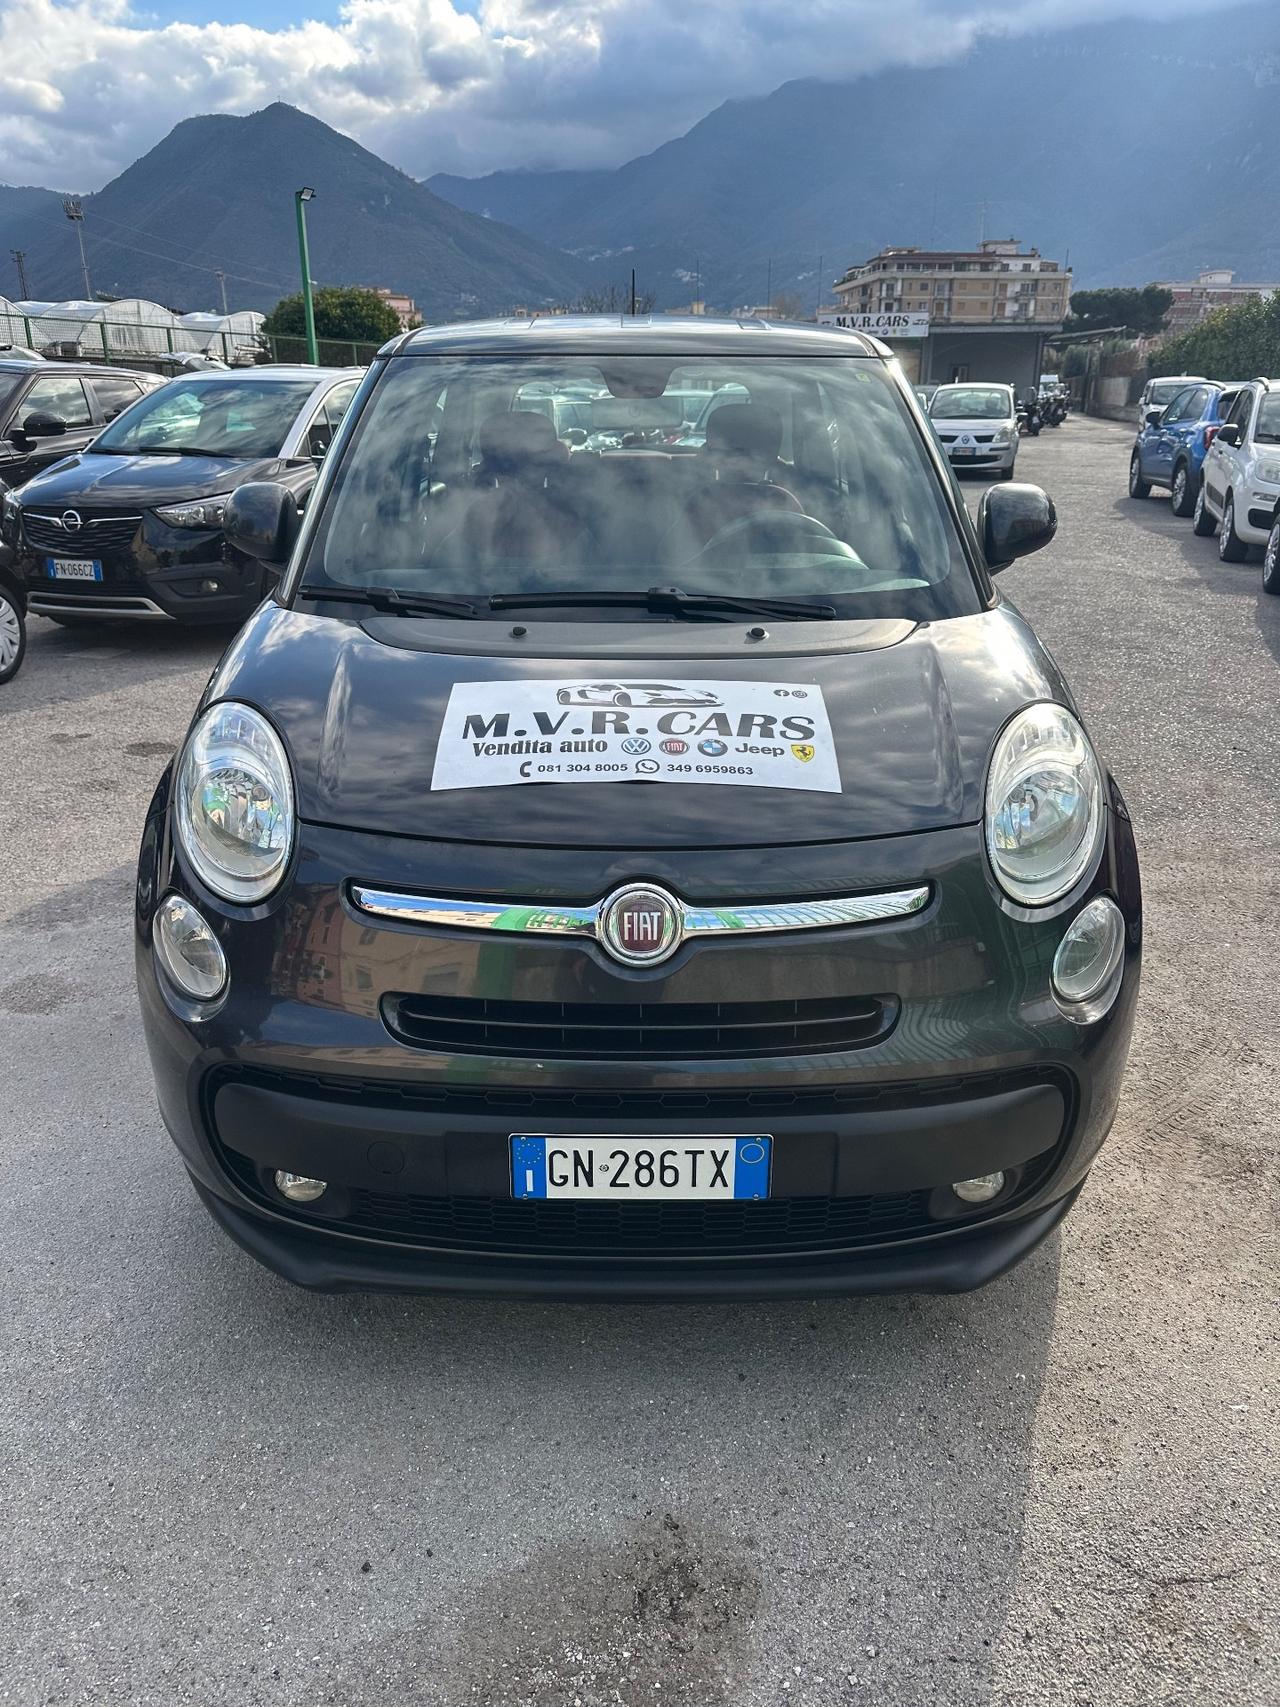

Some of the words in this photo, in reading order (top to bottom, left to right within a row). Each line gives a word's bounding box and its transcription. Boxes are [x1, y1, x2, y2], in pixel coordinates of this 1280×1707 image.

[473, 740, 552, 757] Vendita
[560, 739, 608, 753] auto
[735, 743, 785, 757] Jeep
[538, 764, 561, 773] 081
[566, 764, 591, 772] 304
[595, 764, 628, 772] 8005
[667, 764, 692, 773] 349
[696, 765, 754, 775] 6959863
[623, 911, 661, 941] FIAT
